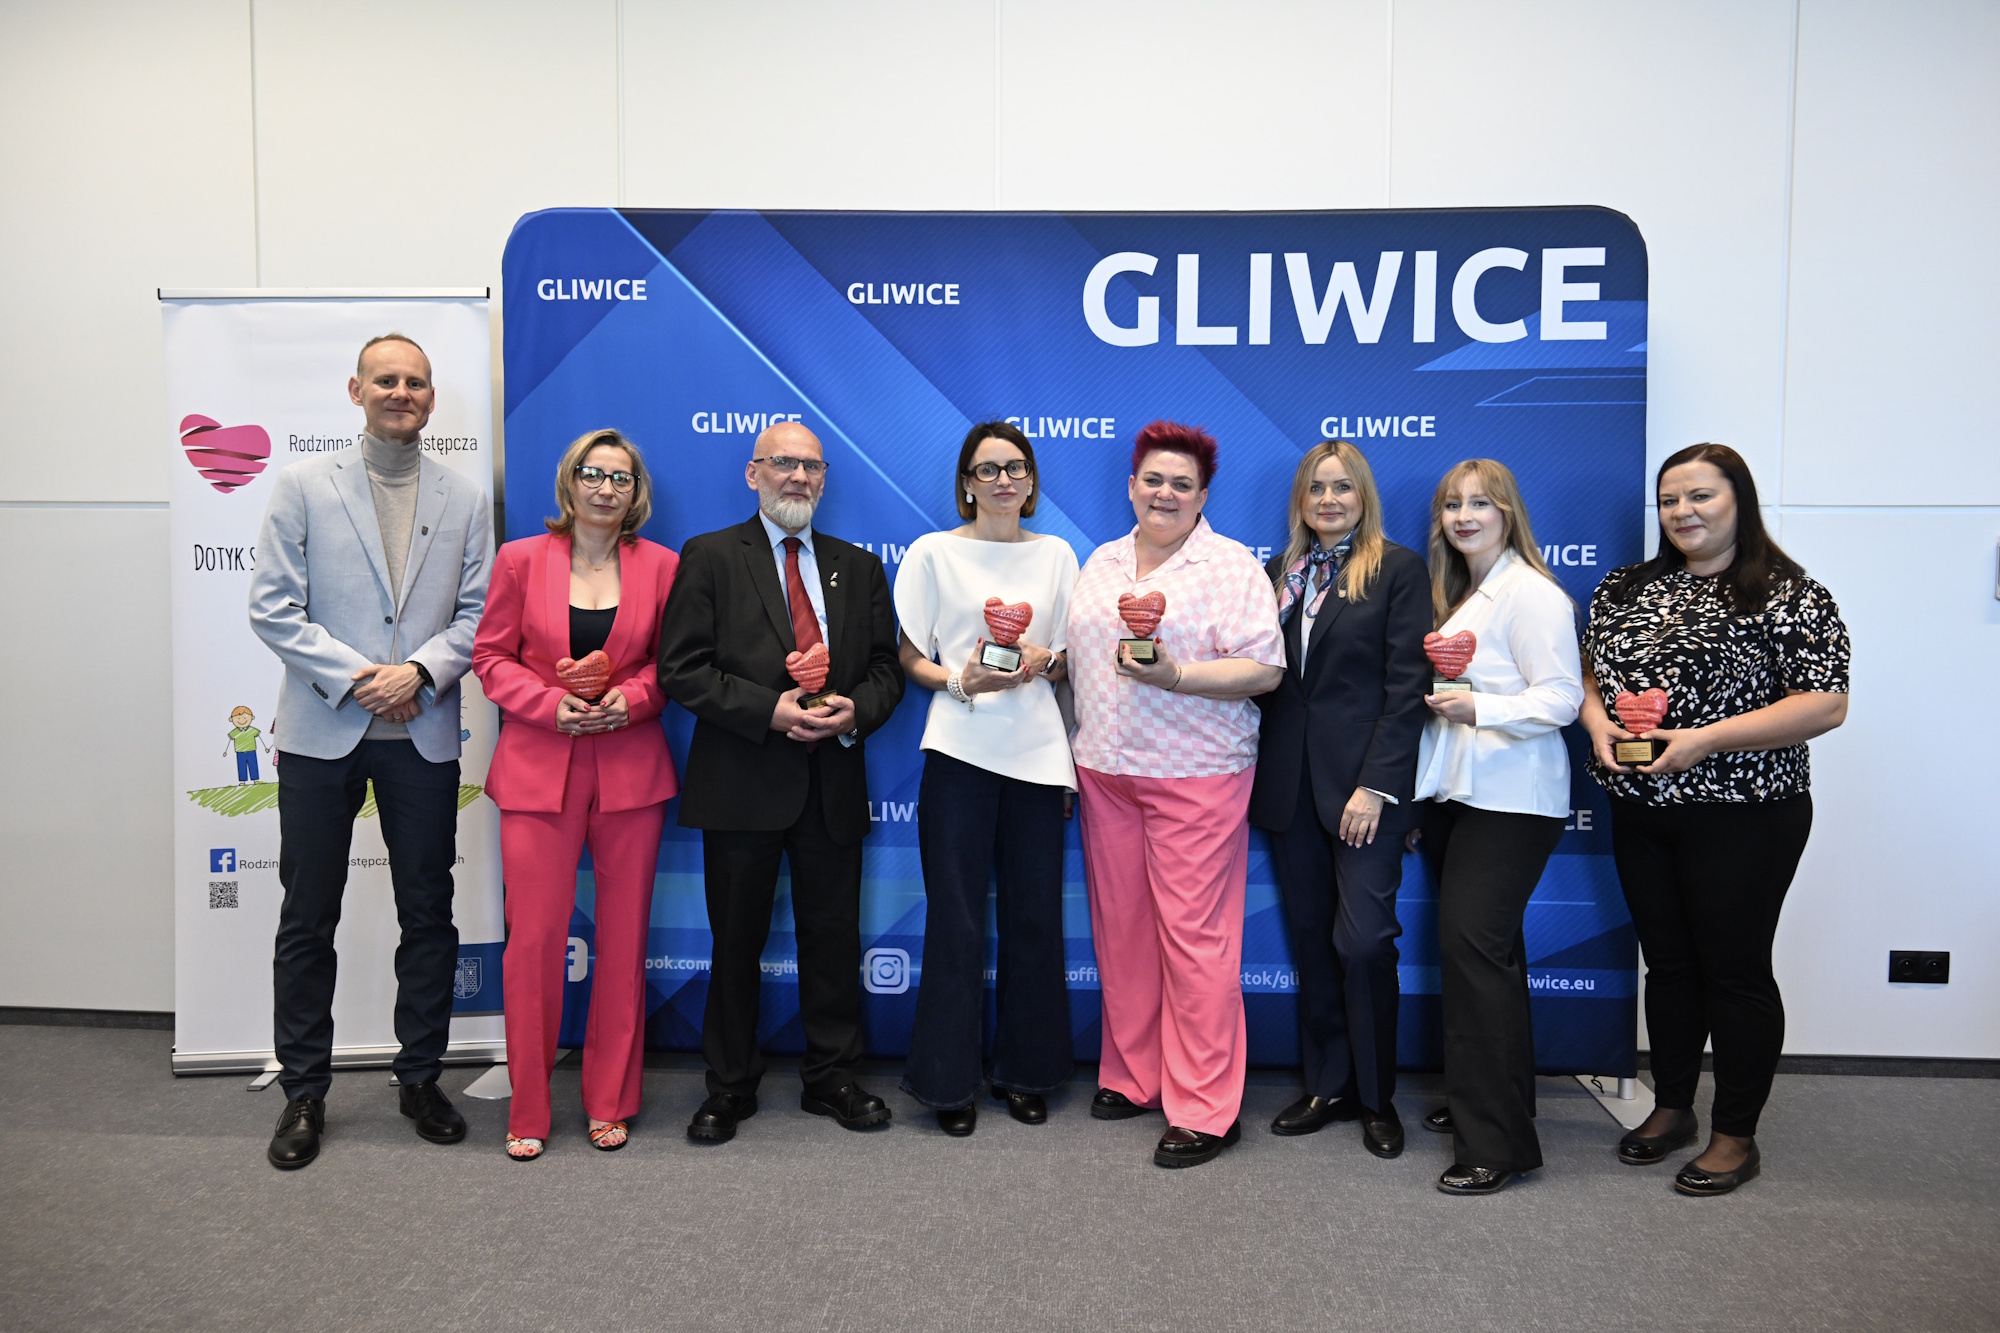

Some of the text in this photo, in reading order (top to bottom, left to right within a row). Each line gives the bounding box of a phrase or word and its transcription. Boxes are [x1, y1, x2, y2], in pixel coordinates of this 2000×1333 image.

[537, 279, 647, 301] GLIWICE
[847, 282, 960, 305] GLIWICE
[1083, 247, 1607, 347] GLIWICE
[1320, 415, 1436, 438] GLIWICE
[194, 544, 245, 571] DOTYK
